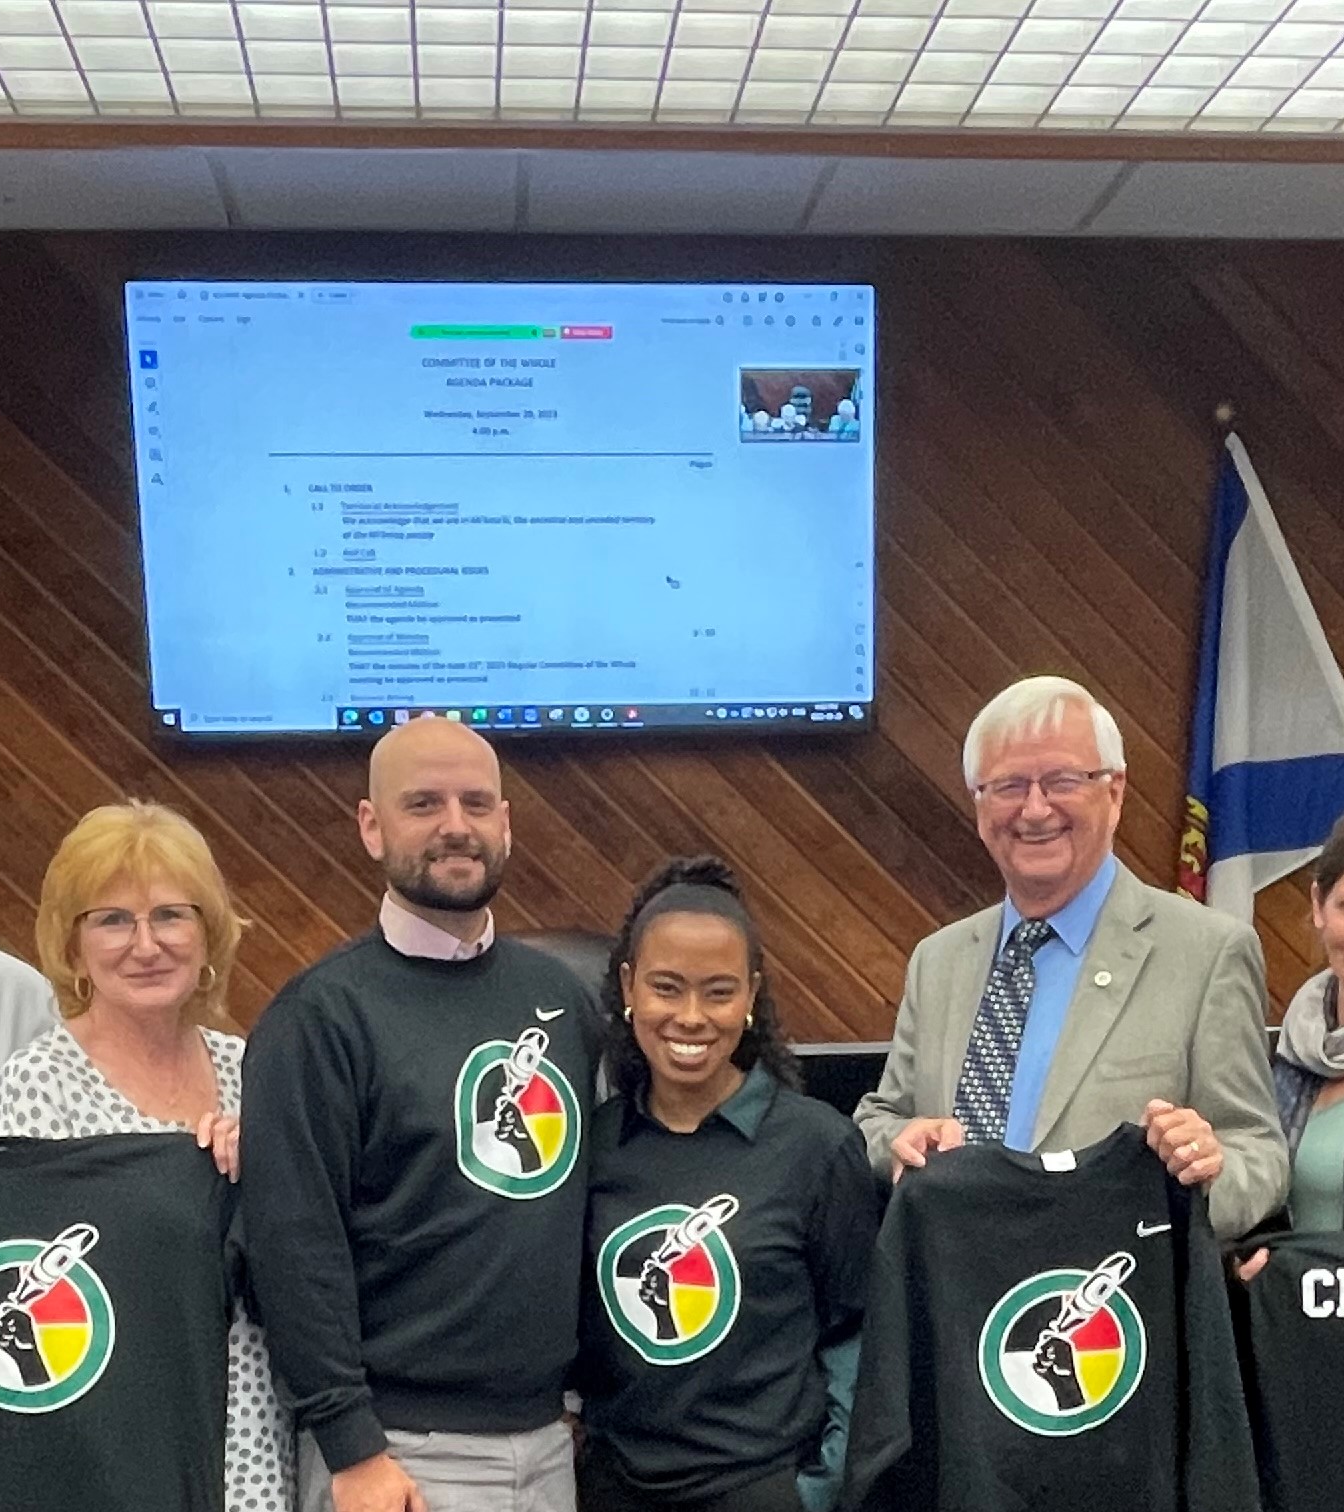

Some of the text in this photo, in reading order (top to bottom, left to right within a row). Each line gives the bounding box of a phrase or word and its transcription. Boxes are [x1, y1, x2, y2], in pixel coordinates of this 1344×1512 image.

[422, 358, 556, 368] COMMITTEE OF THE WHOLE
[446, 377, 534, 388] AGENDA PACKAGE
